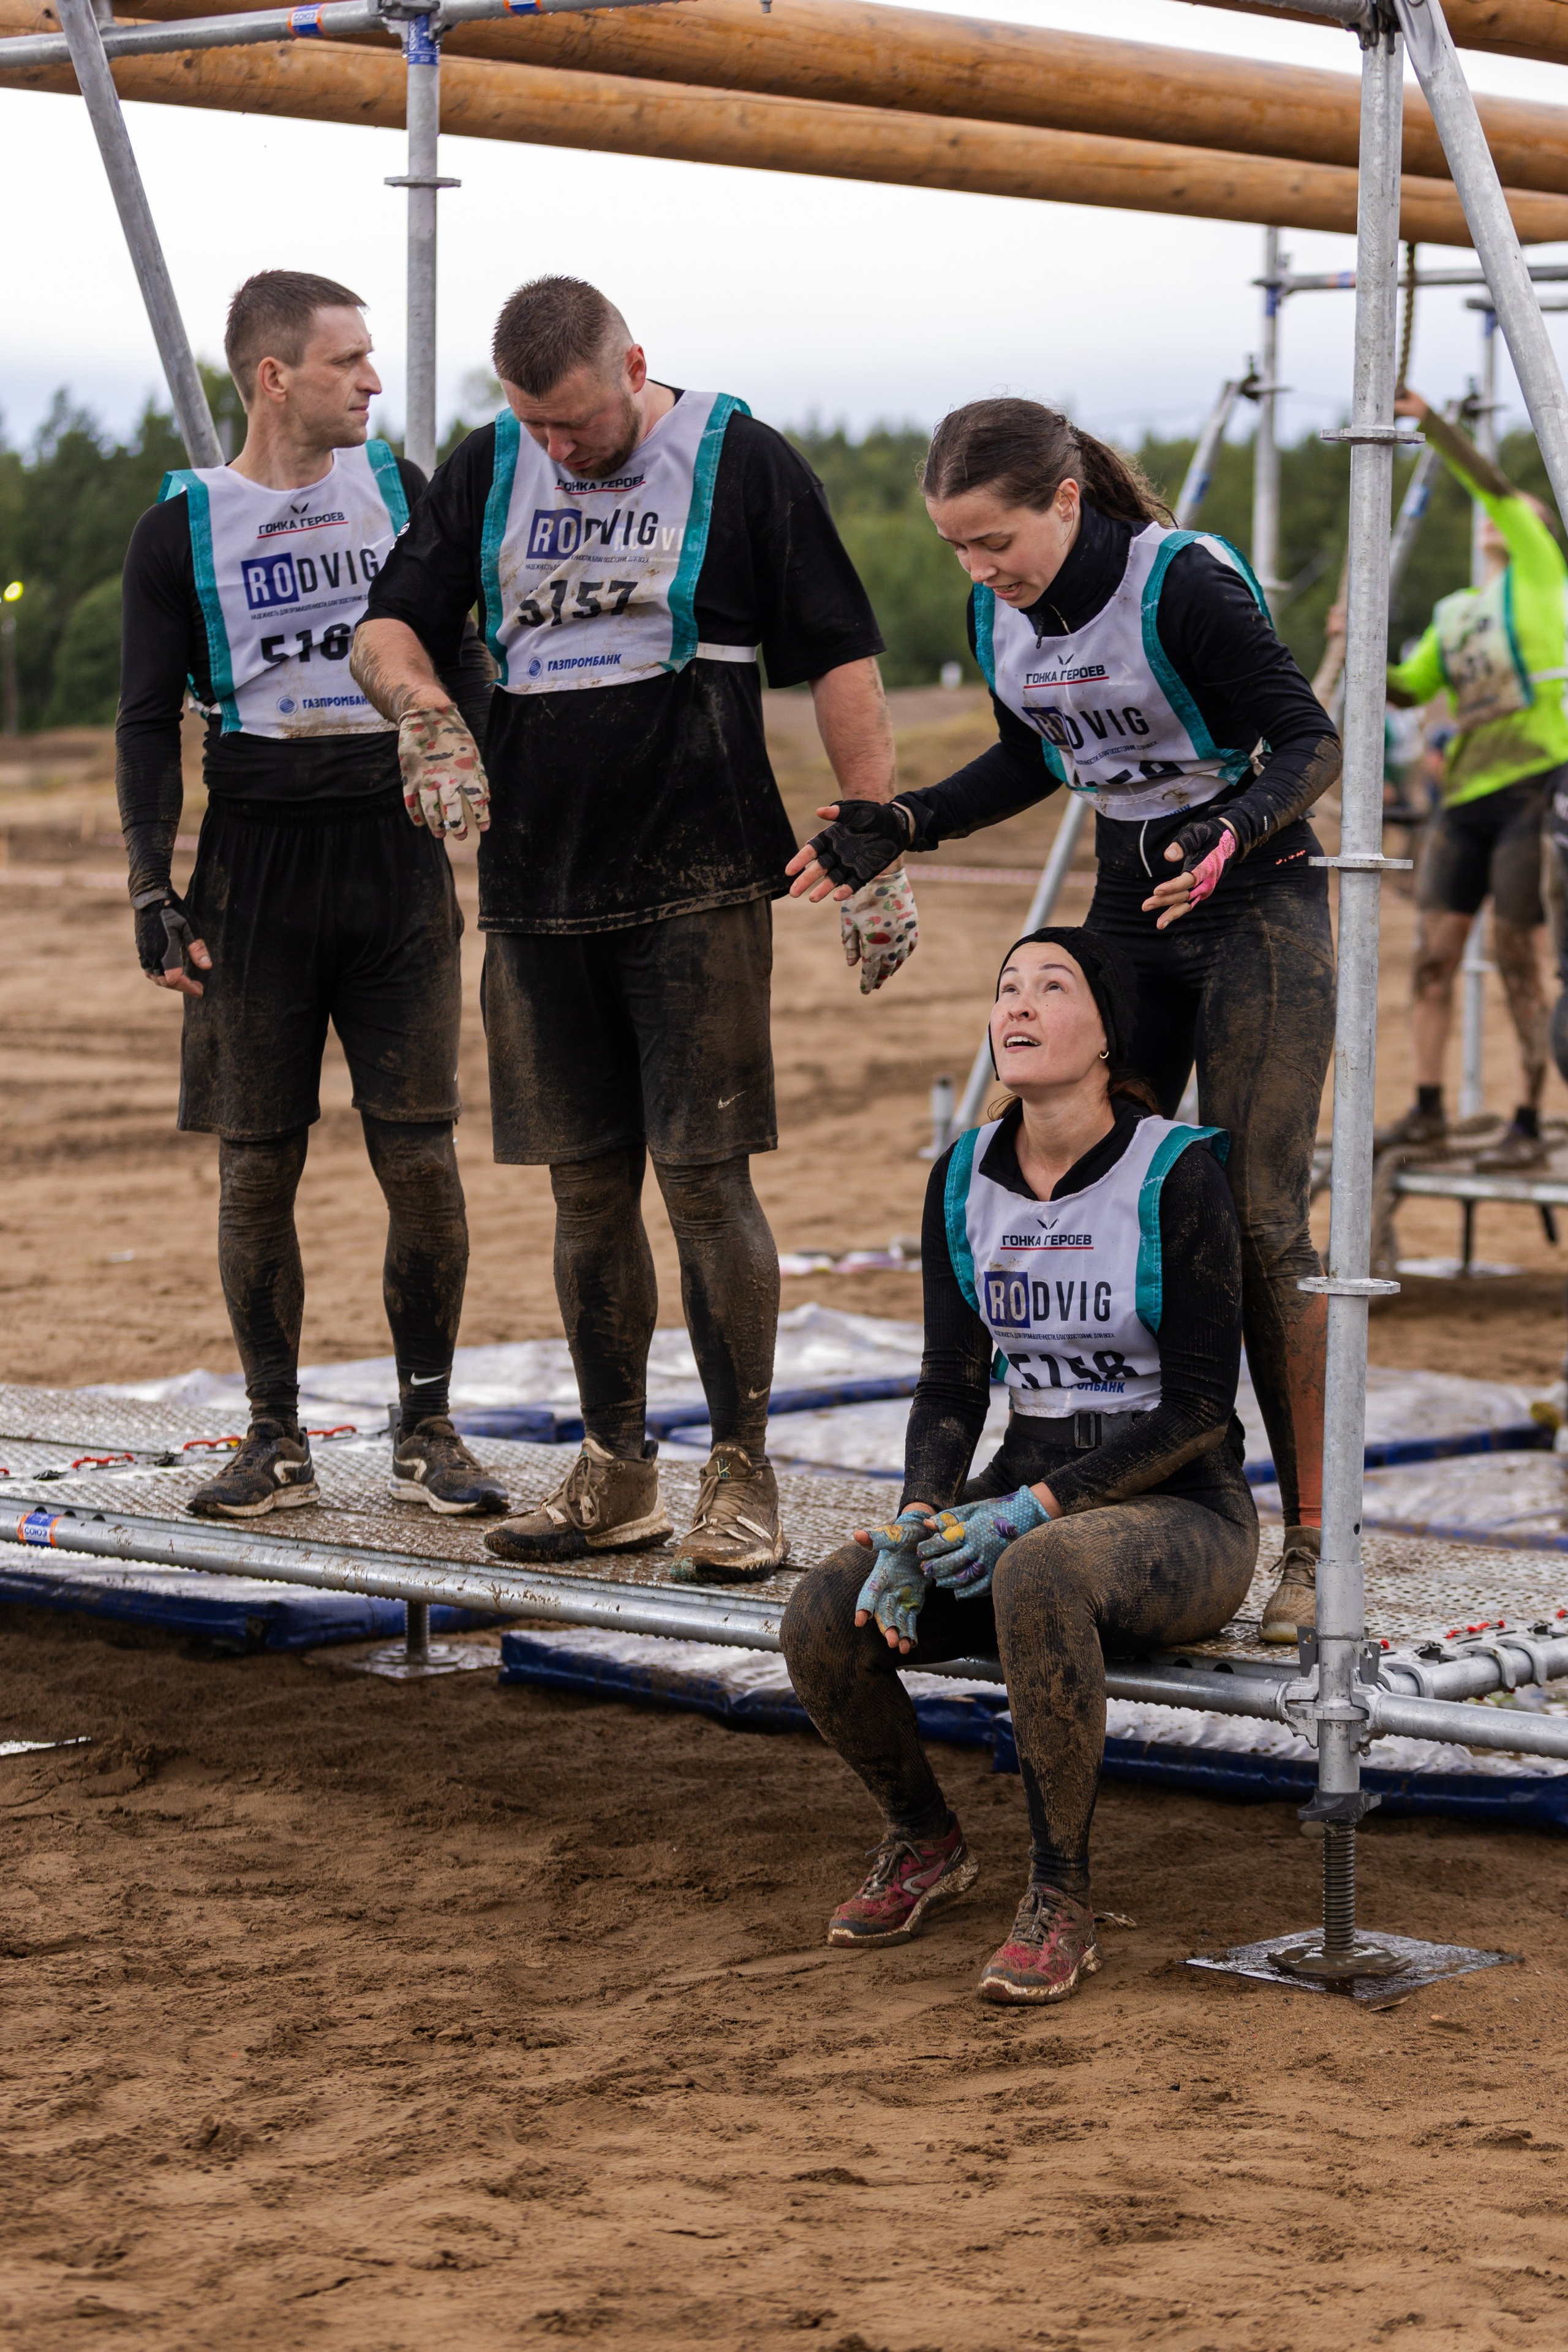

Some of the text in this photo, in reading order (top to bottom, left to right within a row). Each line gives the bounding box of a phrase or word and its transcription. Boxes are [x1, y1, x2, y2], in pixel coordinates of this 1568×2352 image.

[557, 478, 597, 492] ГОНКА
[258, 512, 345, 535] ГОНКА ГЕРОЕВ
[532, 508, 659, 554] RODVIG
[247, 548, 380, 603] RODVIG
[260, 622, 353, 664] 516
[548, 654, 622, 671] ГАЗПРОМБАНК
[1026, 665, 1106, 685] ГОНКА ГЕРОЕВ
[303, 695, 371, 709] ГАЗПРОМБАН
[1030, 706, 1150, 750] RODVIG
[1002, 1234, 1092, 1246] ГОНКА ГЕРОЕВ
[988, 1280, 1112, 1322] RODVIG
